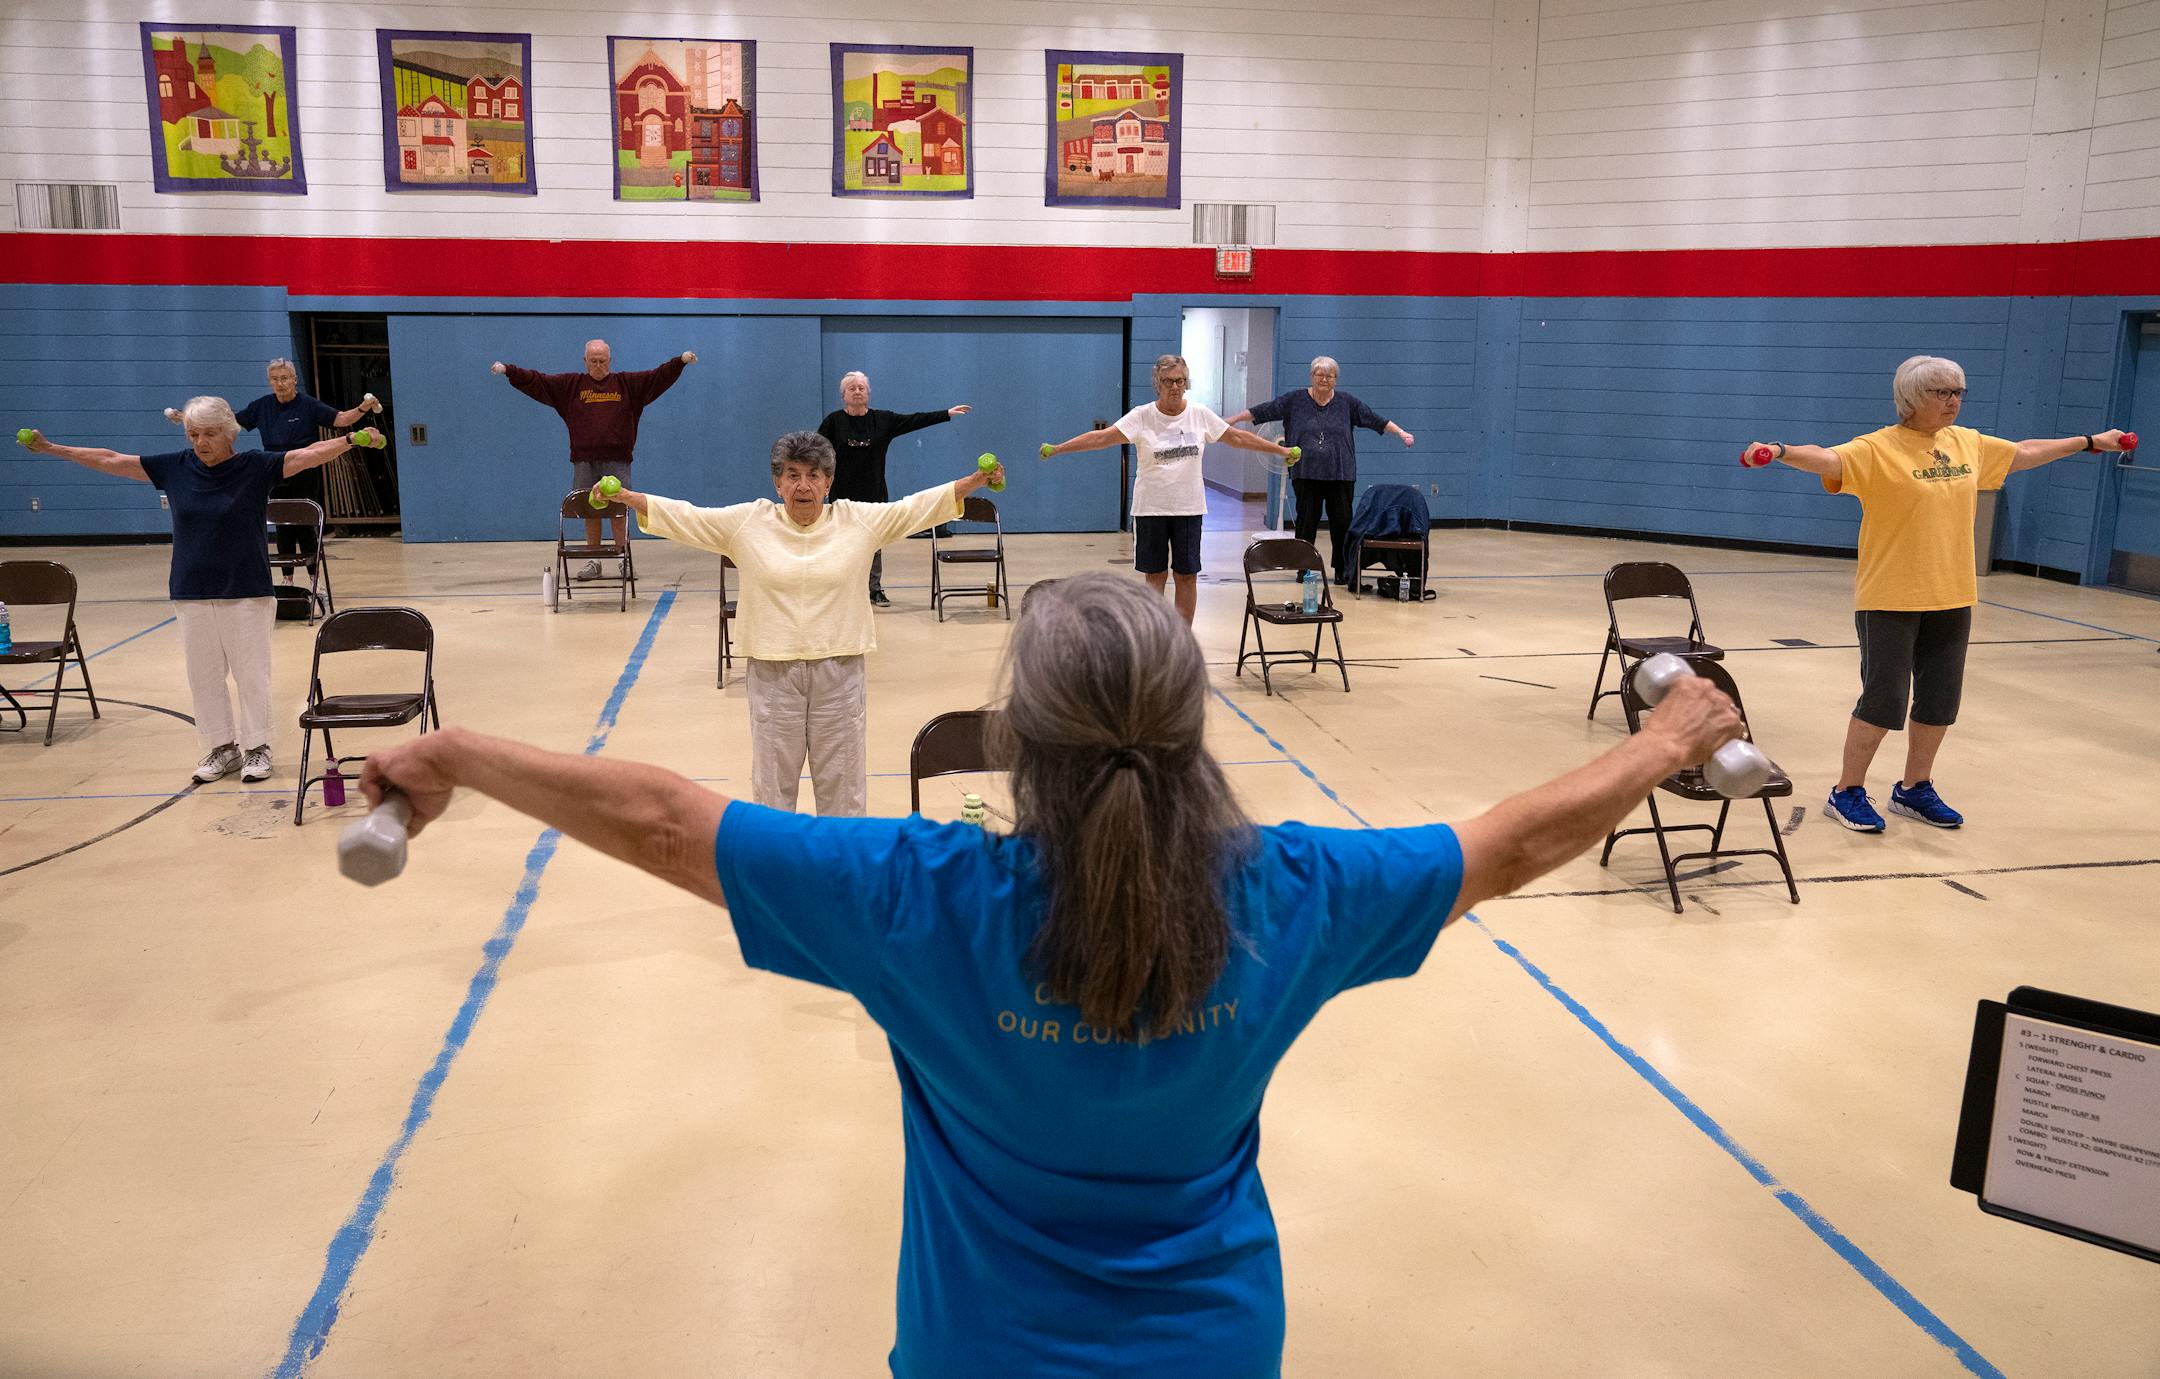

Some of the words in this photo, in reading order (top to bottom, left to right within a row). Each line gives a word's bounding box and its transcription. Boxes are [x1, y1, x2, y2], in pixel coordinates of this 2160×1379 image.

[1223, 252, 1247, 272] EXIT
[997, 1010, 1060, 1043] OUR
[1073, 997, 1239, 1048] CONITY
[2048, 1035, 2097, 1052] STRENGHT
[2099, 1046, 2106, 1054] &
[2108, 1048, 2146, 1062] CARDIO
[2027, 1066, 2056, 1078] LATERAL
[2058, 1073, 2082, 1082] RAISES
[2028, 1055, 2064, 1068] FORWARD
[2066, 1064, 2088, 1072] CHEST
[2090, 1068, 2112, 1078] PRESS
[2024, 1087, 2050, 1098] MARCH
[2026, 1076, 2050, 1086] SQUAT
[2056, 1083, 2078, 1094] CROSS
[2080, 1089, 2106, 1100] PUNCH
[2022, 1108, 2048, 1118] MARCH
[2024, 1098, 2049, 1108] HUSTLE
[2050, 1104, 2070, 1113] WITH
[2020, 1118, 2048, 1130] DOUBLE
[2050, 1126, 2065, 1134] SIDE
[2067, 1130, 2084, 1138] STEP
[2052, 1136, 2078, 1146] HUSTLE
[2016, 1159, 2054, 1174] OVERHEAD
[2055, 1170, 2076, 1180] PRESS
[2017, 1149, 2034, 1158] ROW
[2044, 1156, 2067, 1166] TRICEP
[2069, 1162, 2110, 1177] EXTENSION
